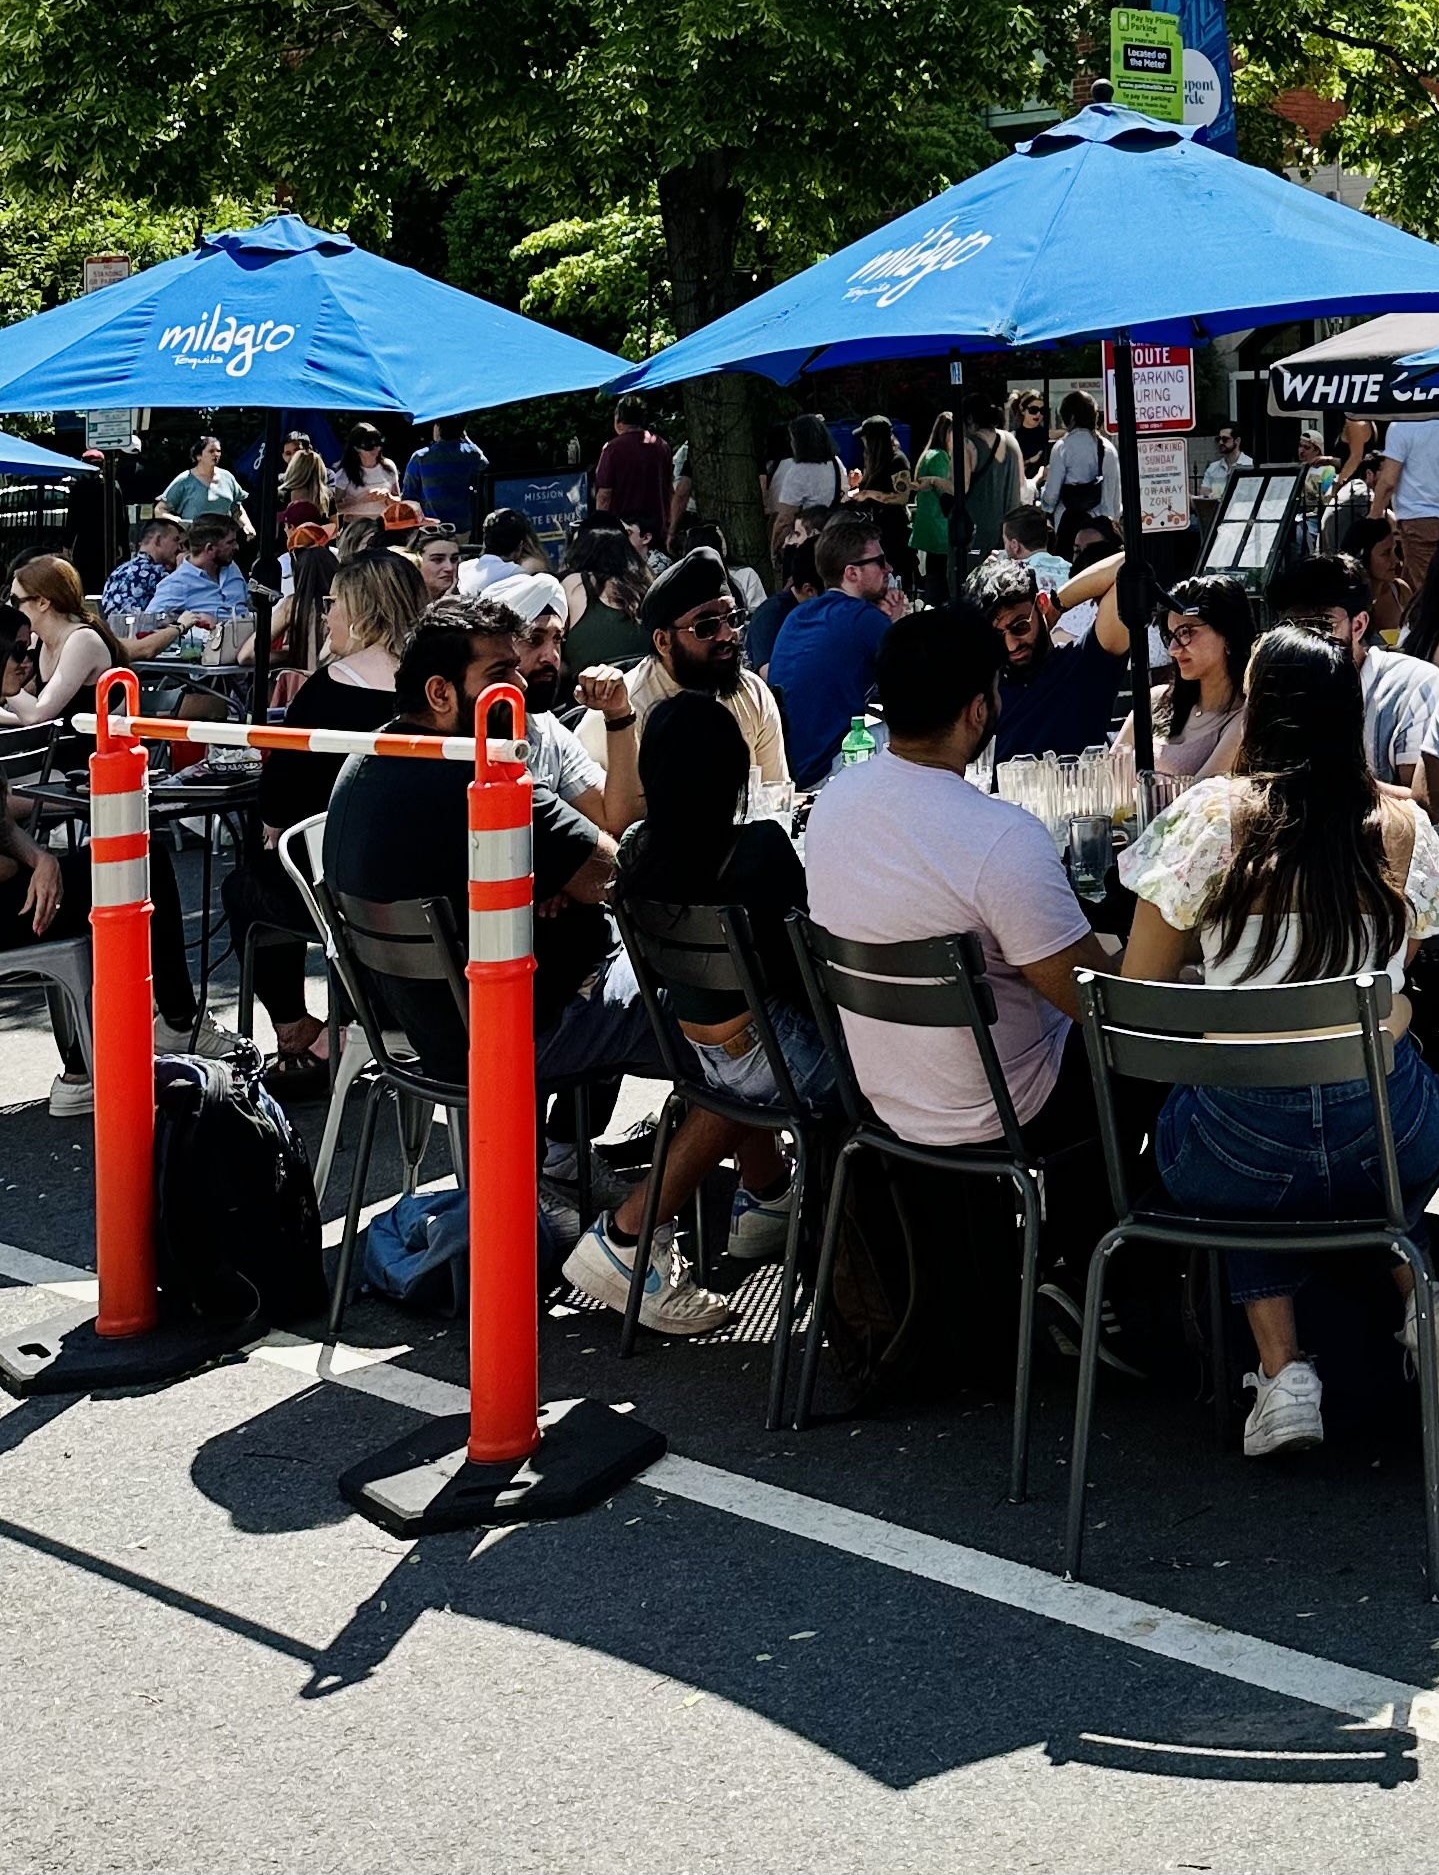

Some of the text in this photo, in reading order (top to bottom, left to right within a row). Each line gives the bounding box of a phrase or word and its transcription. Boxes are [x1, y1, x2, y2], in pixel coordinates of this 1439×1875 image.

[1131, 14, 1177, 26] Pay by Phone
[1131, 23, 1157, 34] Parking
[1128, 48, 1157, 59] Located
[1130, 58, 1165, 69] the Meter
[1184, 91, 1205, 105] rcle
[158, 303, 296, 377] milagro
[171, 354, 224, 370] Tequila
[1134, 347, 1171, 365] OUTE
[1133, 369, 1184, 385] PARKING
[1283, 372, 1384, 404] WHITE
[1135, 387, 1171, 403] URING
[1135, 404, 1185, 420] ERGENCY
[1145, 454, 1175, 465] SUNDAY
[524, 490, 564, 502] MISSION
[1143, 485, 1184, 496] OW-AWAY
[1149, 496, 1173, 506] ZONE
